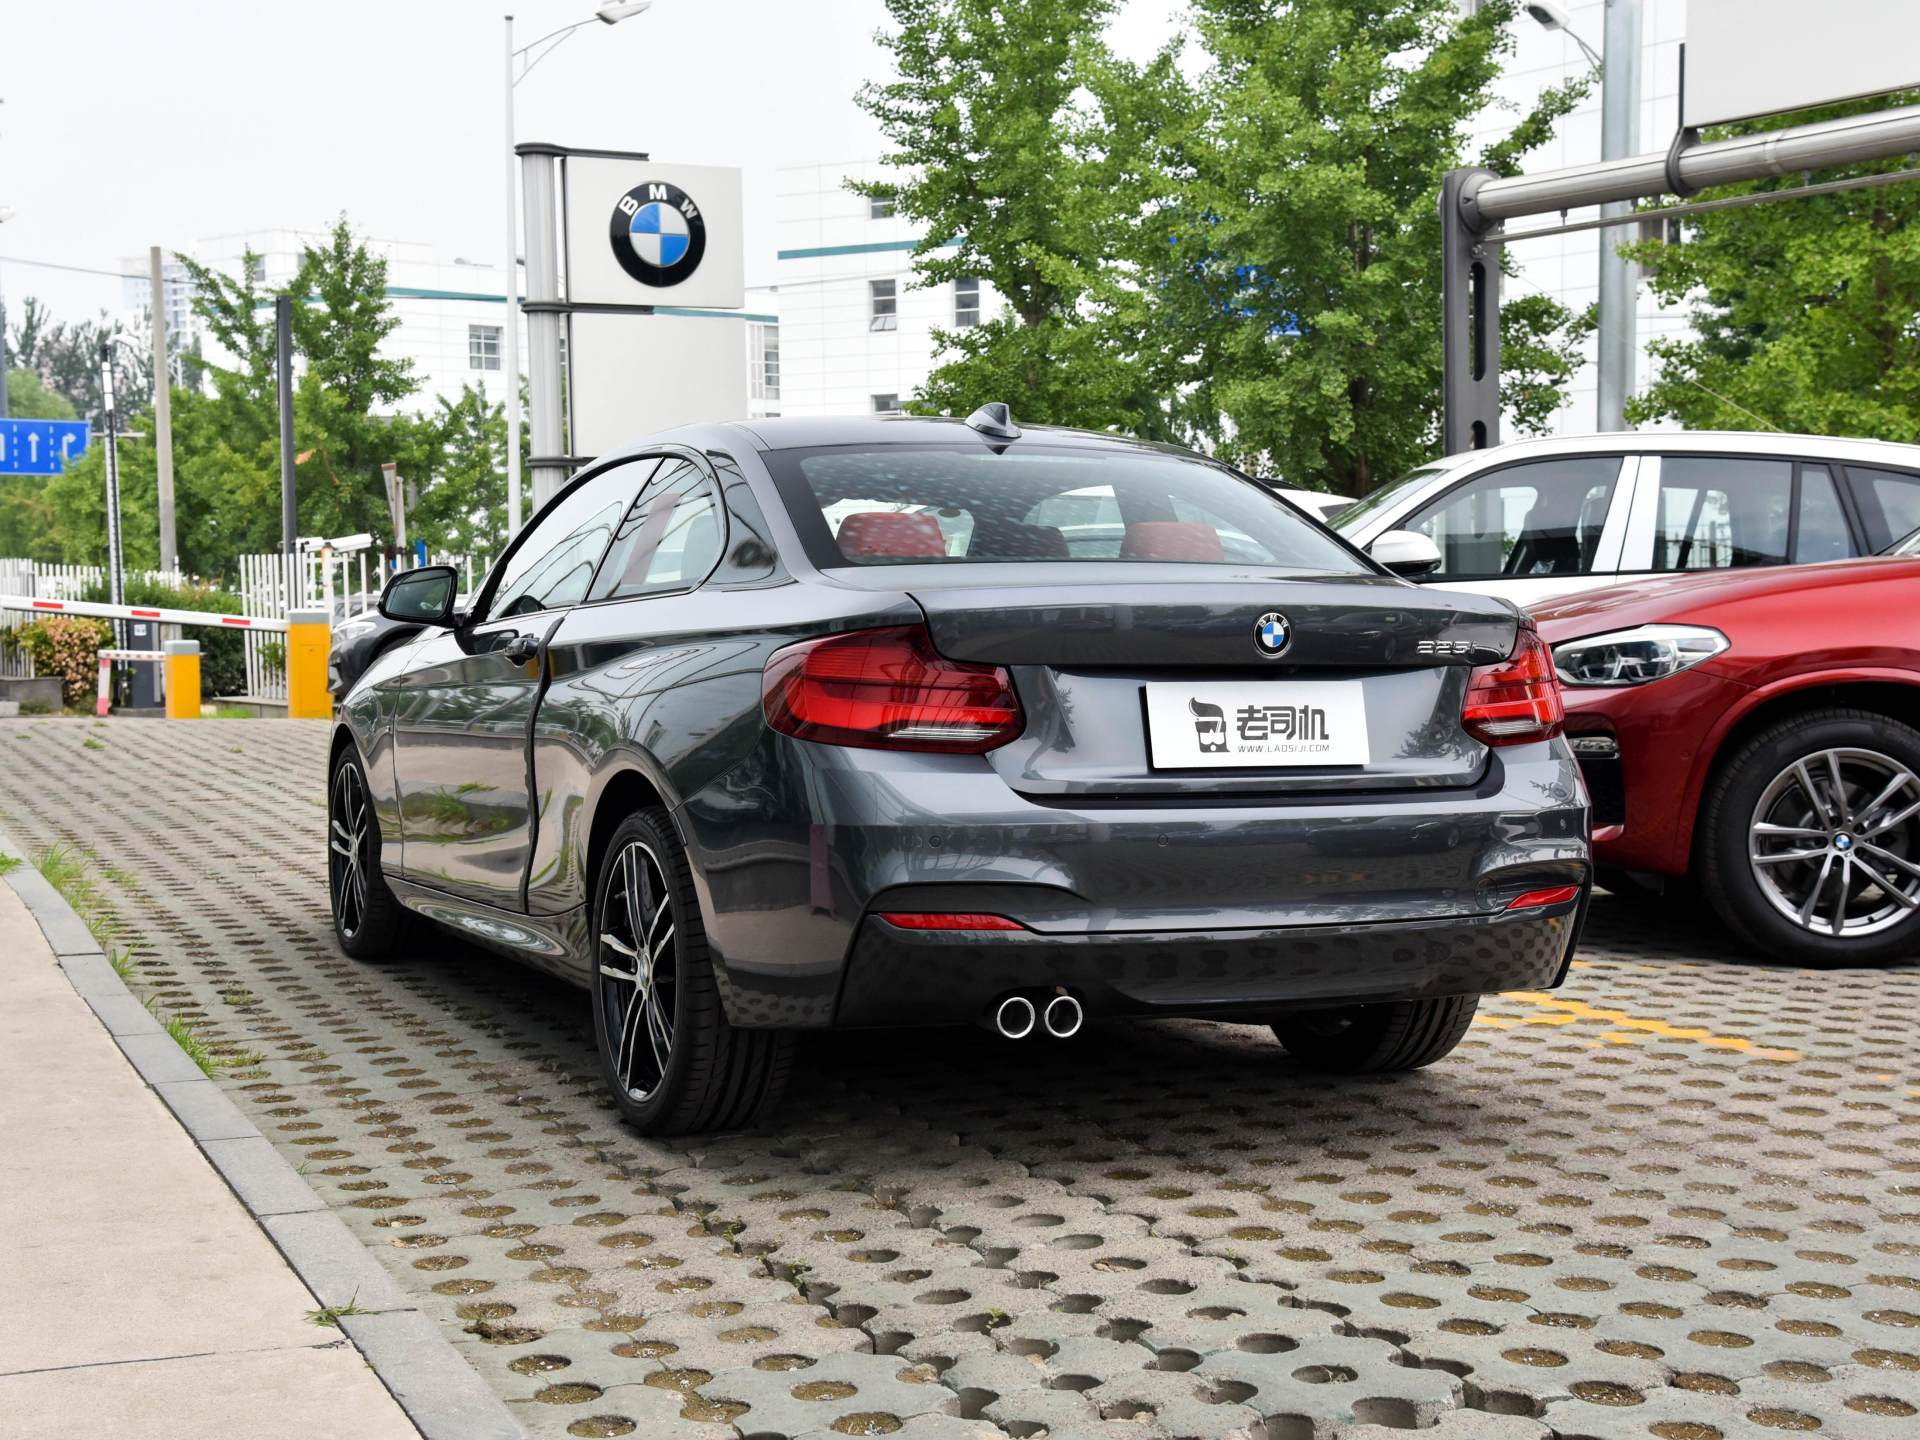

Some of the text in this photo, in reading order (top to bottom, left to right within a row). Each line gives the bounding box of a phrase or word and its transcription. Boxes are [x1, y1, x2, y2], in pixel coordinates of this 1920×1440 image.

[619, 184, 698, 219] BMW
[1258, 614, 1289, 628] BMW
[1236, 705, 1330, 741] 老司机
[1237, 744, 1330, 753] WWW.LAOSIJI.COM
